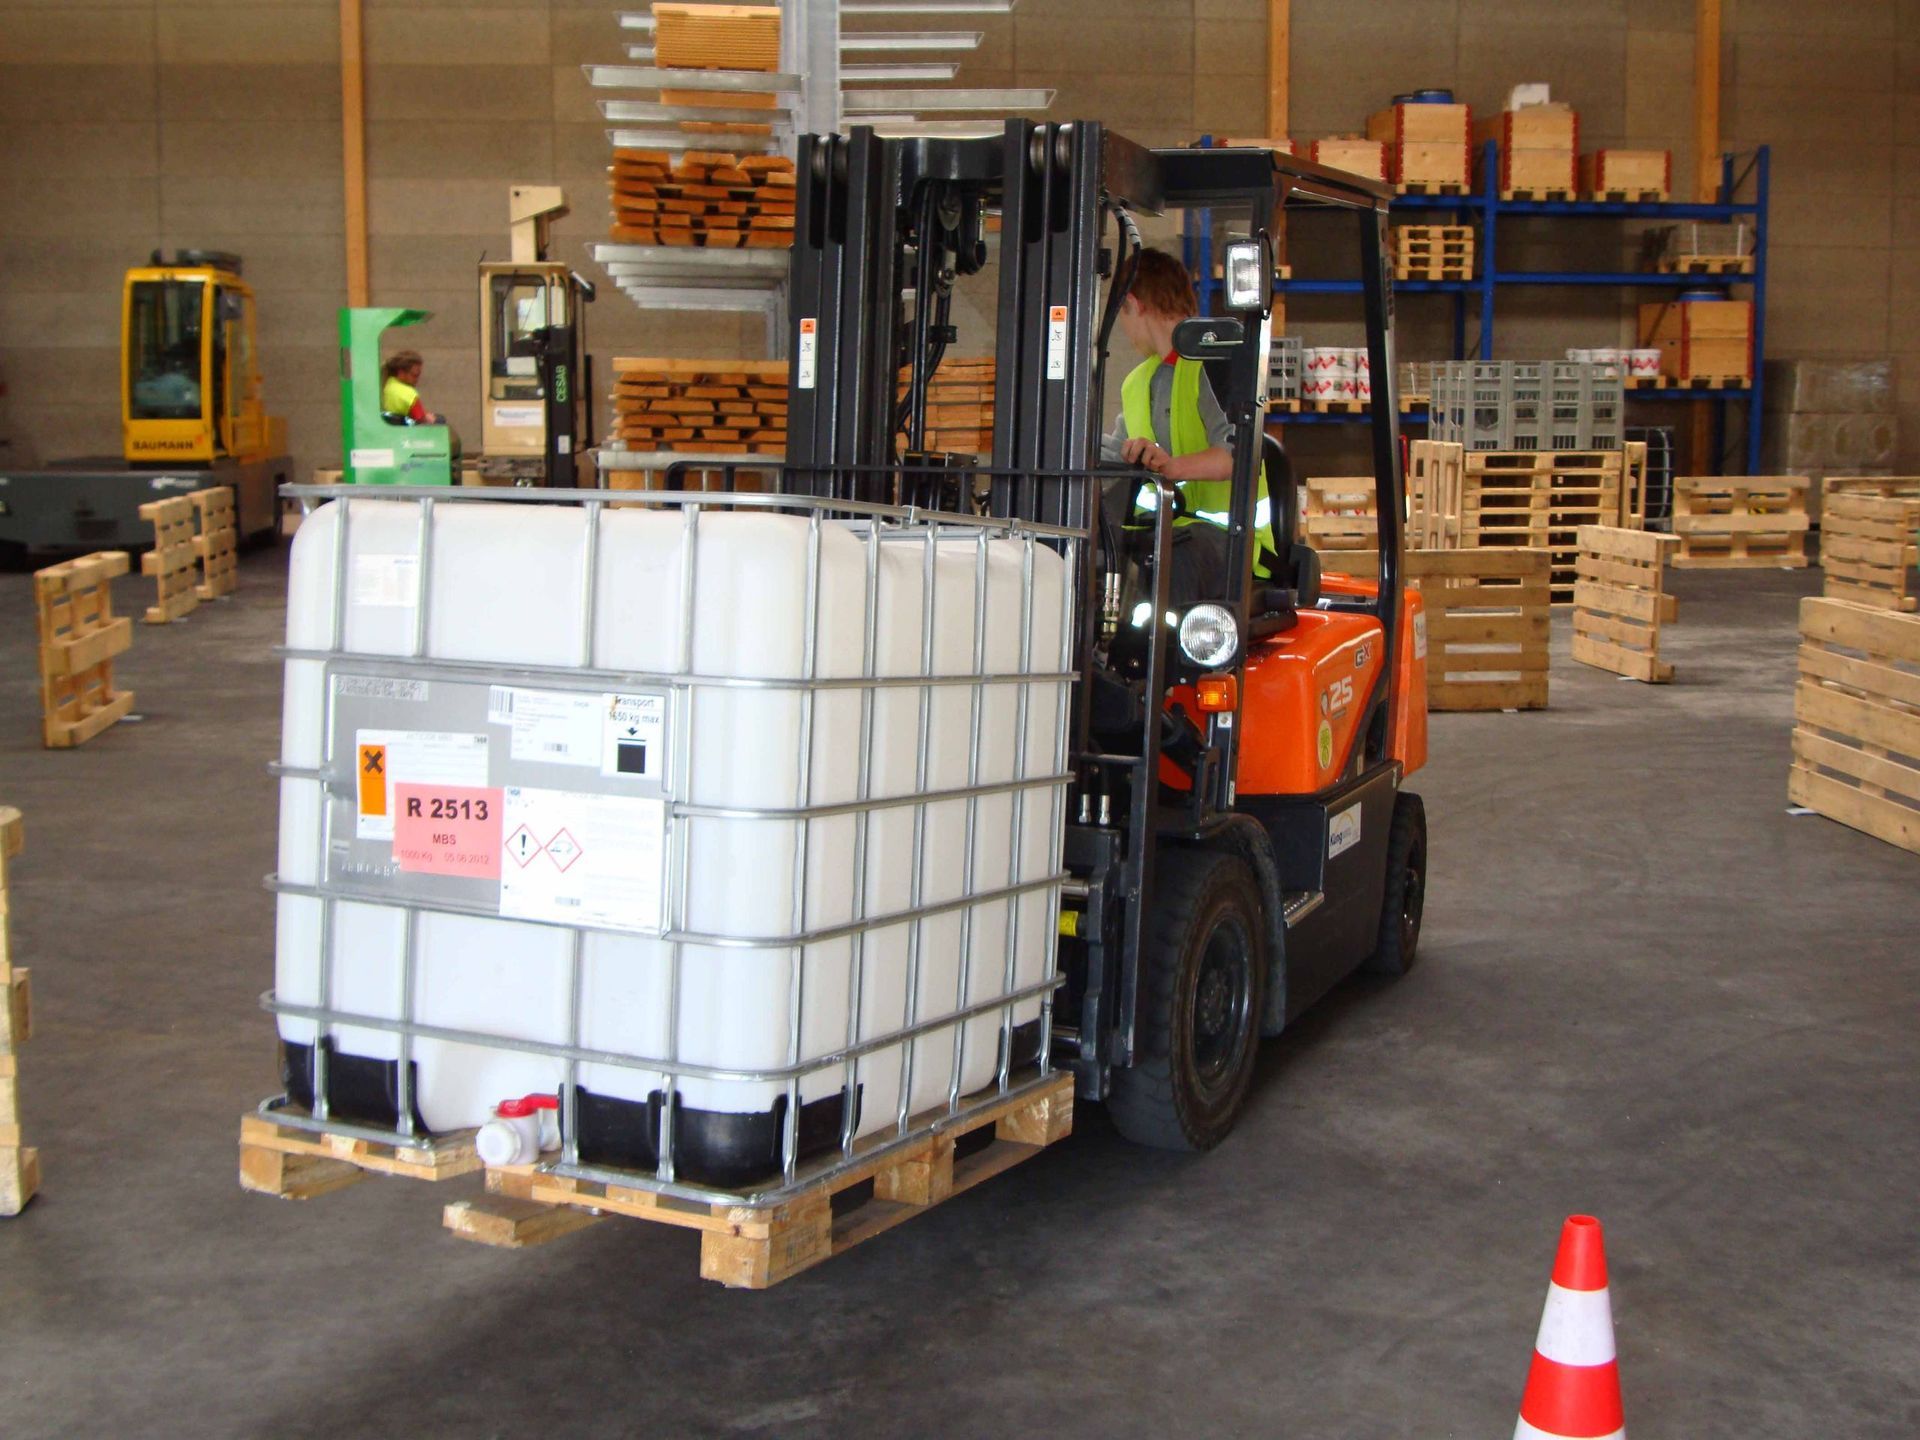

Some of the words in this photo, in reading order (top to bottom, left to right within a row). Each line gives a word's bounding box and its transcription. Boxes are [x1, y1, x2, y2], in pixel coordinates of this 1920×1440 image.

[556, 365, 567, 402] CESAB
[132, 440, 193, 450] BAUMANN
[1354, 640, 1372, 669] GX
[1329, 675, 1353, 712] 25
[628, 713, 640, 725] kg
[641, 715, 660, 724] max
[407, 797, 422, 818] R
[430, 798, 489, 821] 2513
[432, 833, 457, 846] MBS
